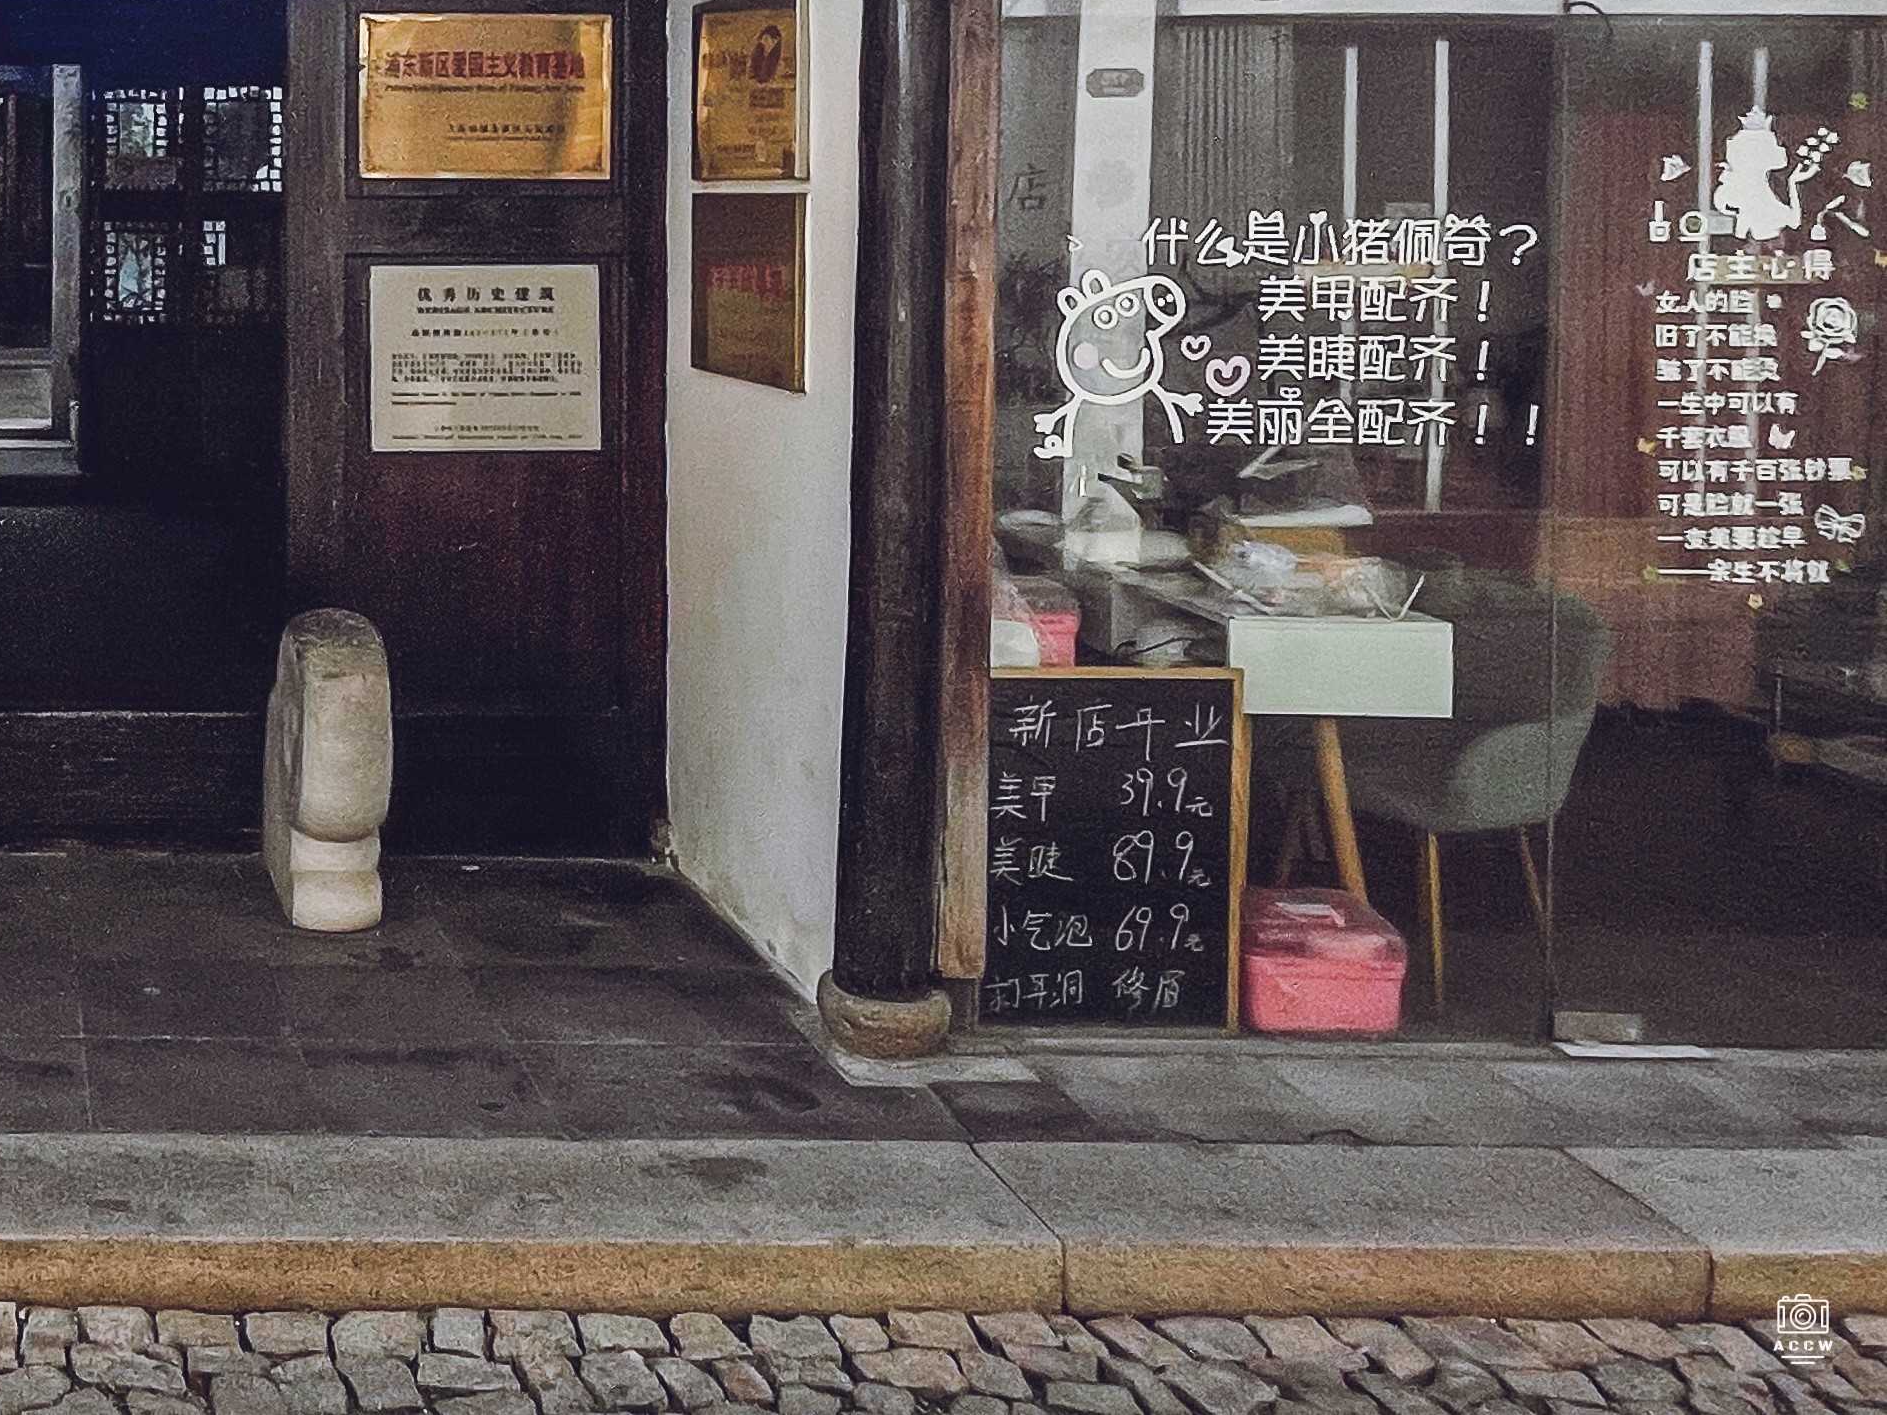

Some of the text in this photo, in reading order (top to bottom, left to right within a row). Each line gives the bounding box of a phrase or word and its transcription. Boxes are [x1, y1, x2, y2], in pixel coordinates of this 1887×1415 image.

[417, 287, 556, 302] 优秀历史建筑
[1657, 391, 1800, 416] 一生中可以有
[990, 768, 1214, 822] 美甲 39.9元
